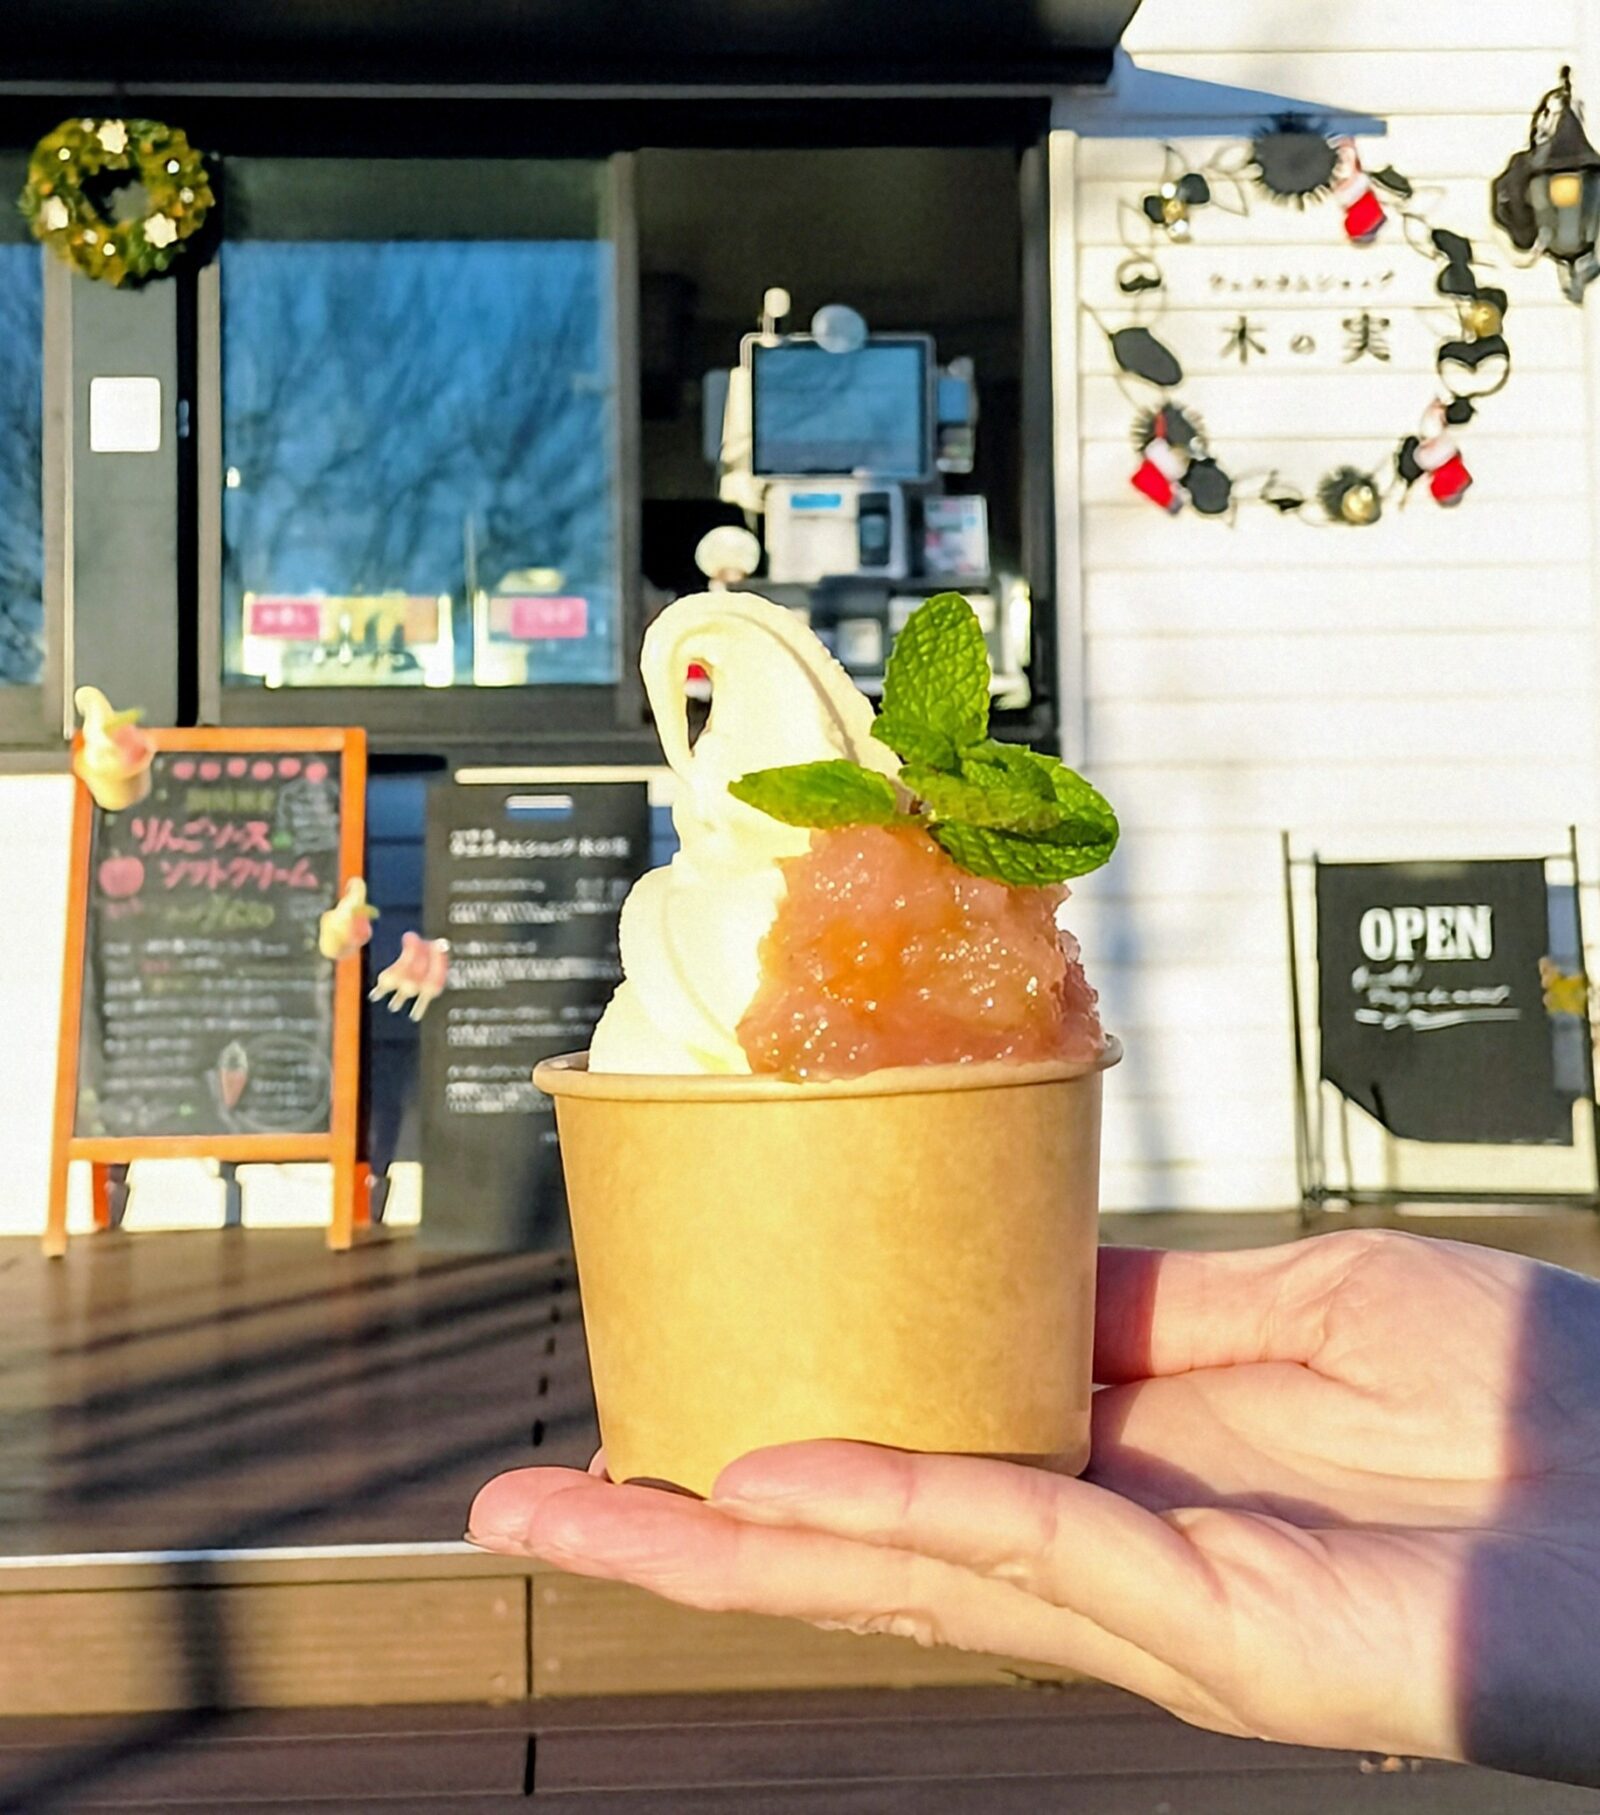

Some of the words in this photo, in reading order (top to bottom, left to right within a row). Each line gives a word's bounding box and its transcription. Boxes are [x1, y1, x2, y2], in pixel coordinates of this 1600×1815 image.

[1219, 313, 1391, 365] 木の実
[130, 817, 272, 855] りんごソース
[159, 856, 319, 891] ソフトクリーム
[1359, 904, 1494, 961] OPEN
